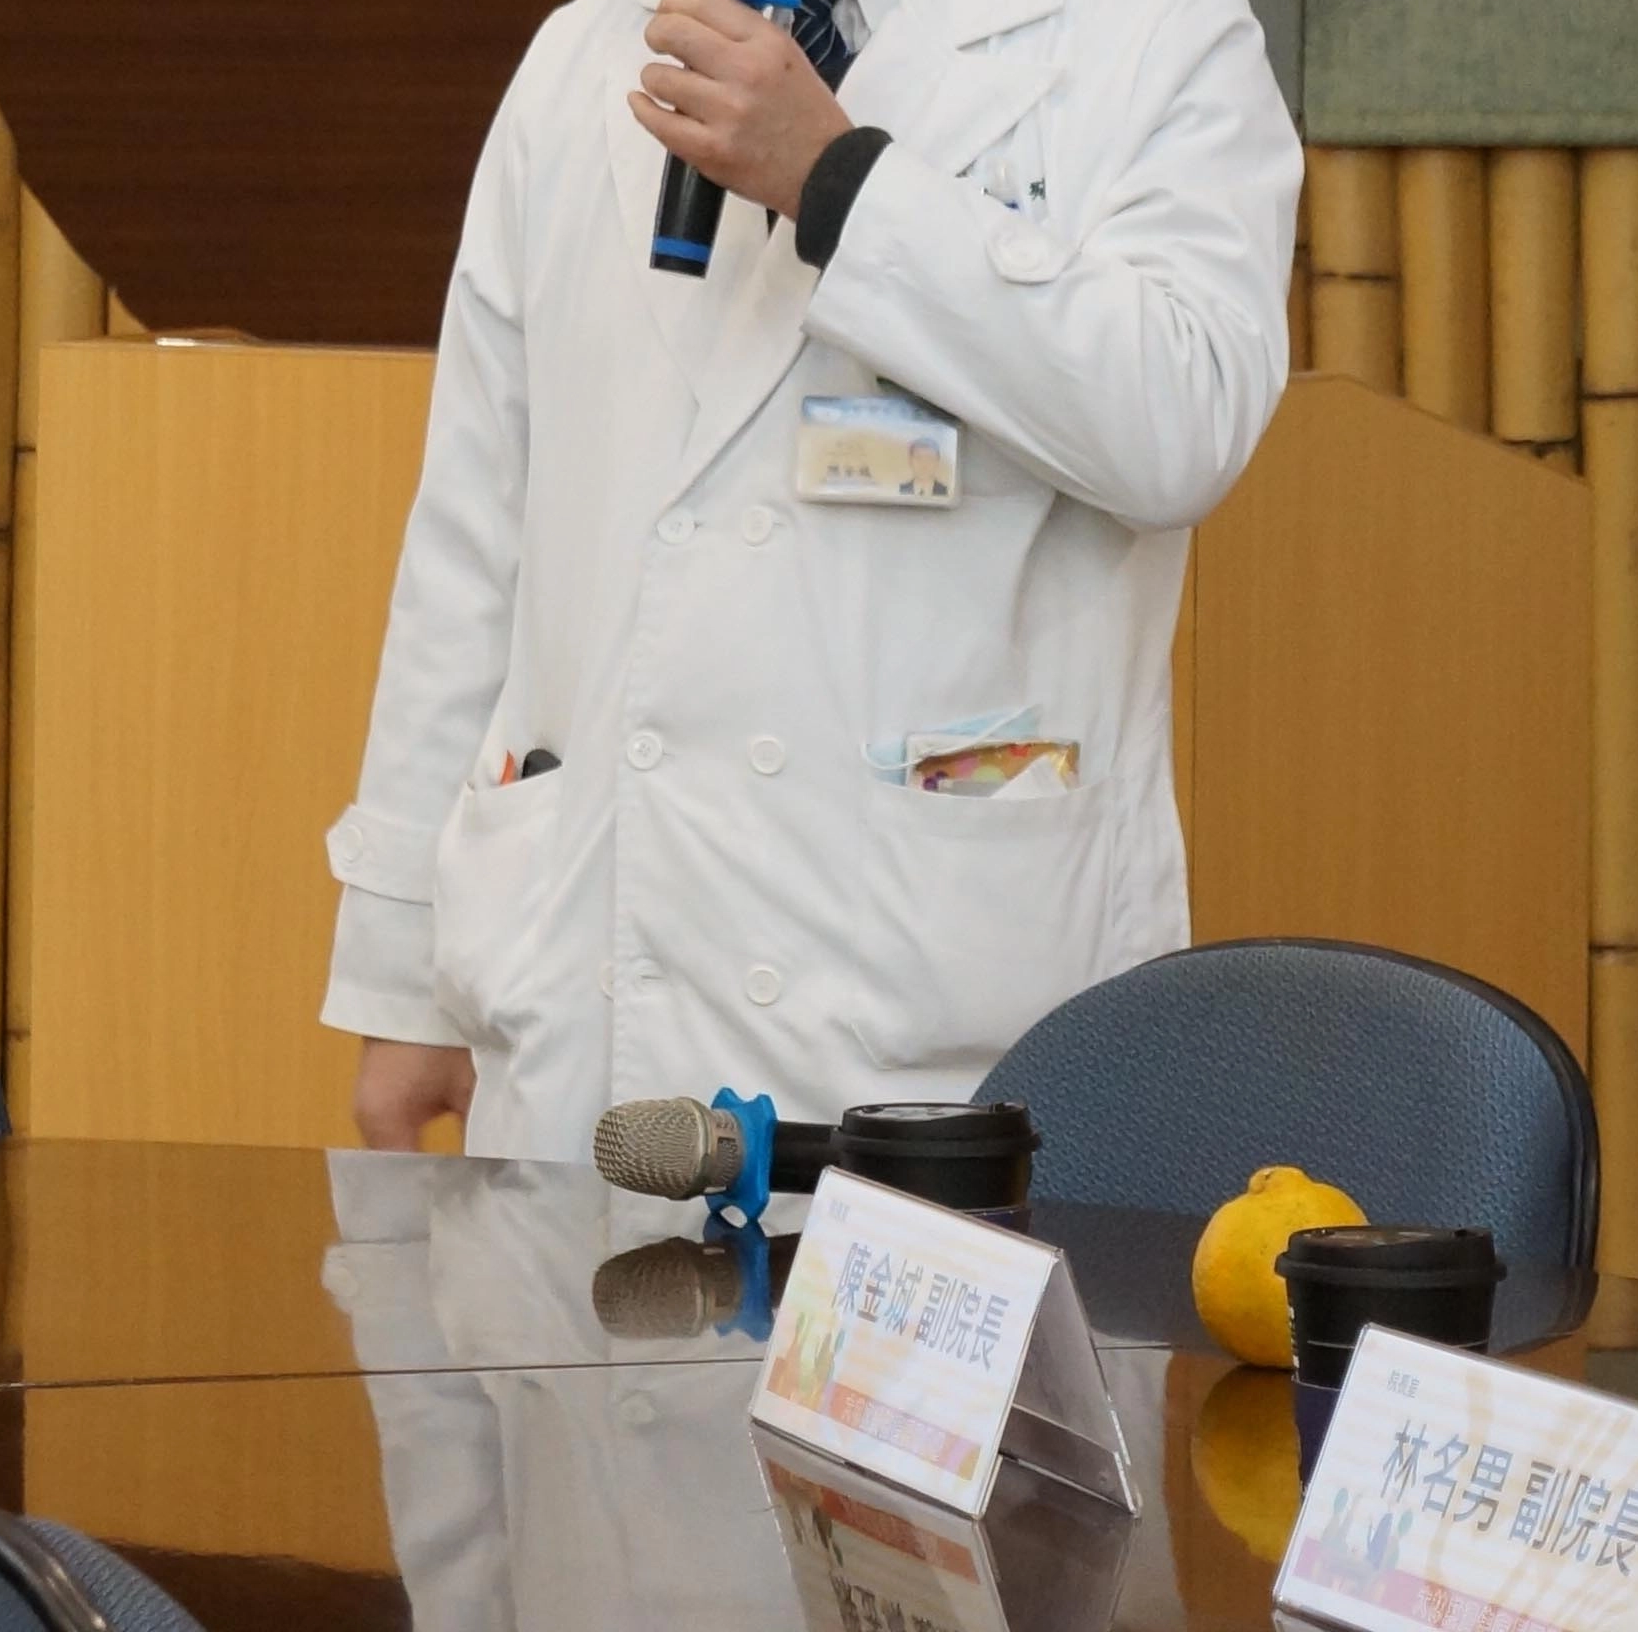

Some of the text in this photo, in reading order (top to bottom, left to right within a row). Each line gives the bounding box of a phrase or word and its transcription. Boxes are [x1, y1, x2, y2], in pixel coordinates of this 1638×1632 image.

[914, 1272, 1010, 1371] 副院長
[1380, 1419, 1513, 1531] 林名男
